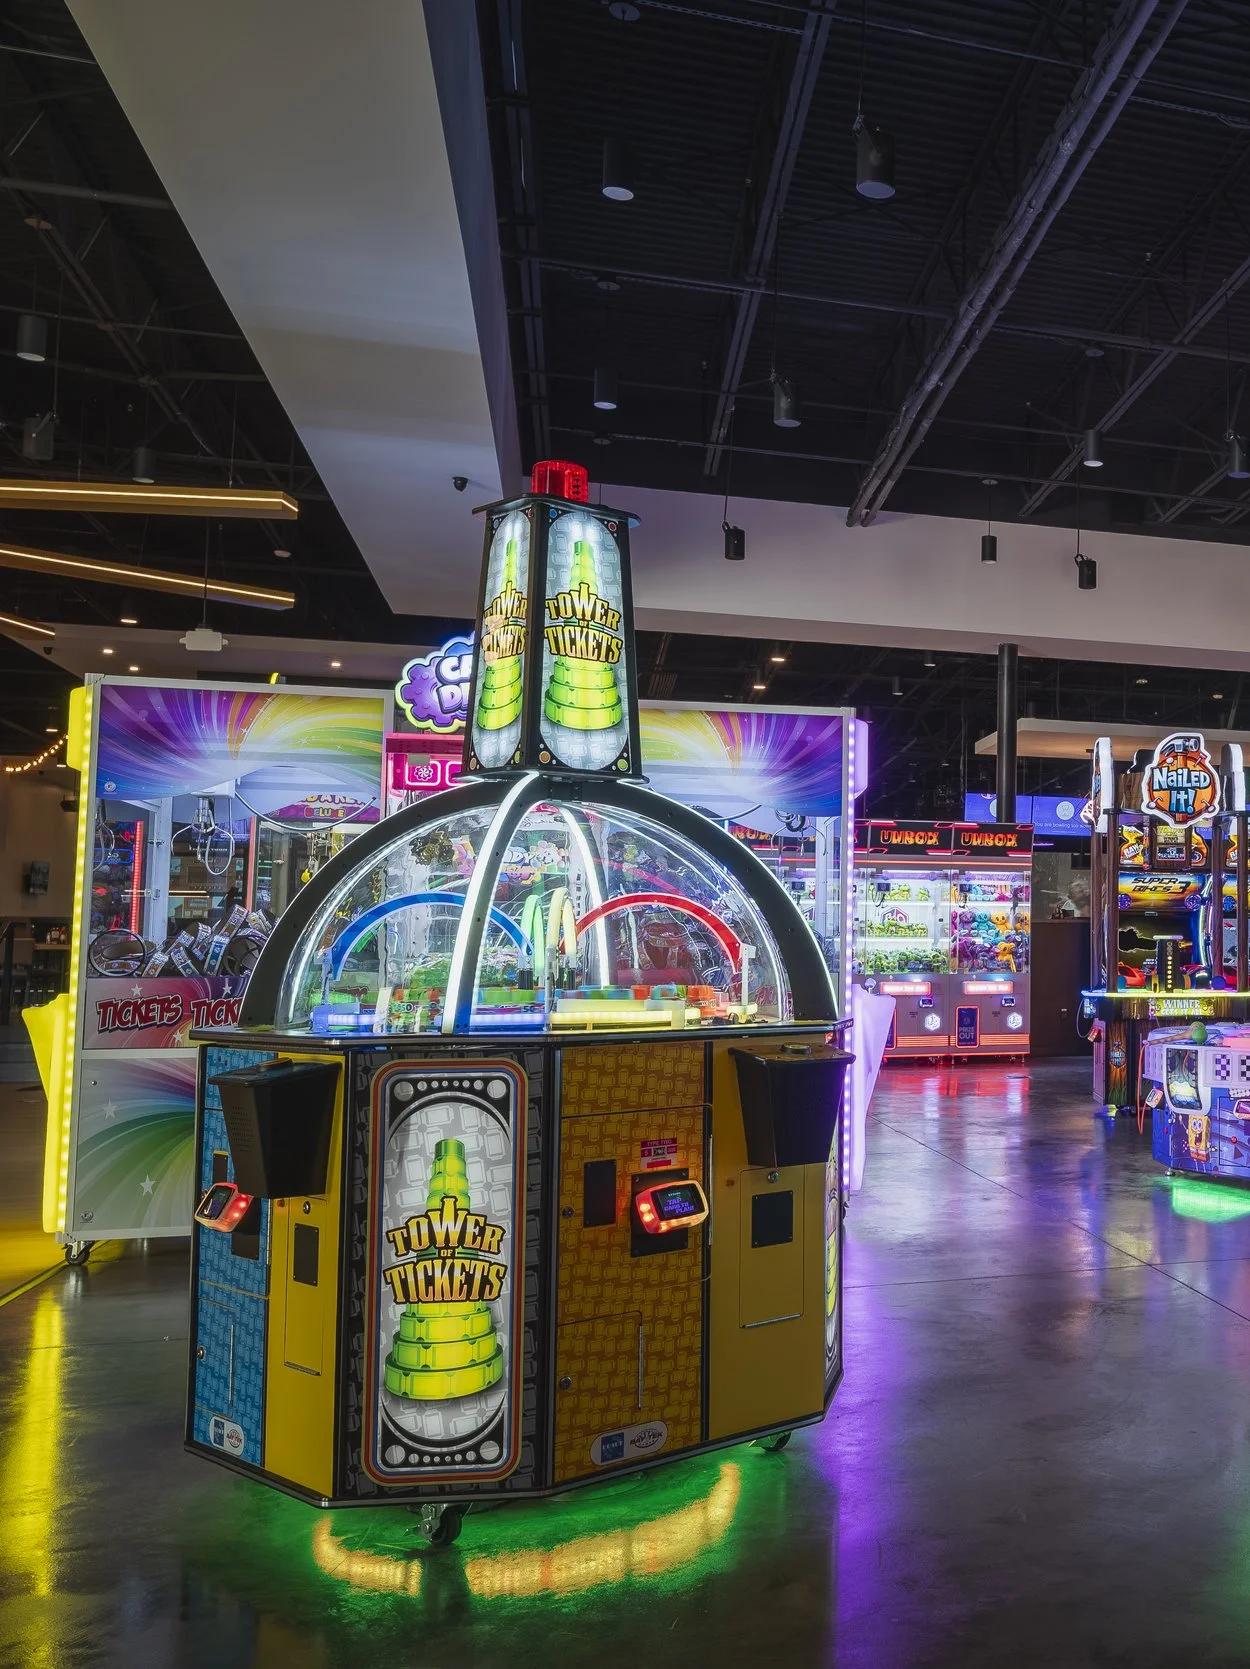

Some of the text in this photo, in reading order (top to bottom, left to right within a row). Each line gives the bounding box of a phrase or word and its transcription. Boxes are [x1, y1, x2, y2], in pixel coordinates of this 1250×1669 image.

[484, 581, 528, 621] TOWER
[545, 583, 622, 632] TOWER
[545, 625, 624, 664] TICKETS
[880, 830, 939, 846] UNBOX
[961, 832, 1018, 847] UNBOX
[96, 993, 184, 1034] TICKETS
[1162, 999, 1201, 1009] WINNER
[958, 1026, 975, 1034] PRIZE
[386, 1195, 506, 1257] TOWER
[440, 1249, 454, 1257] OF
[383, 1258, 508, 1304] TICKETS
